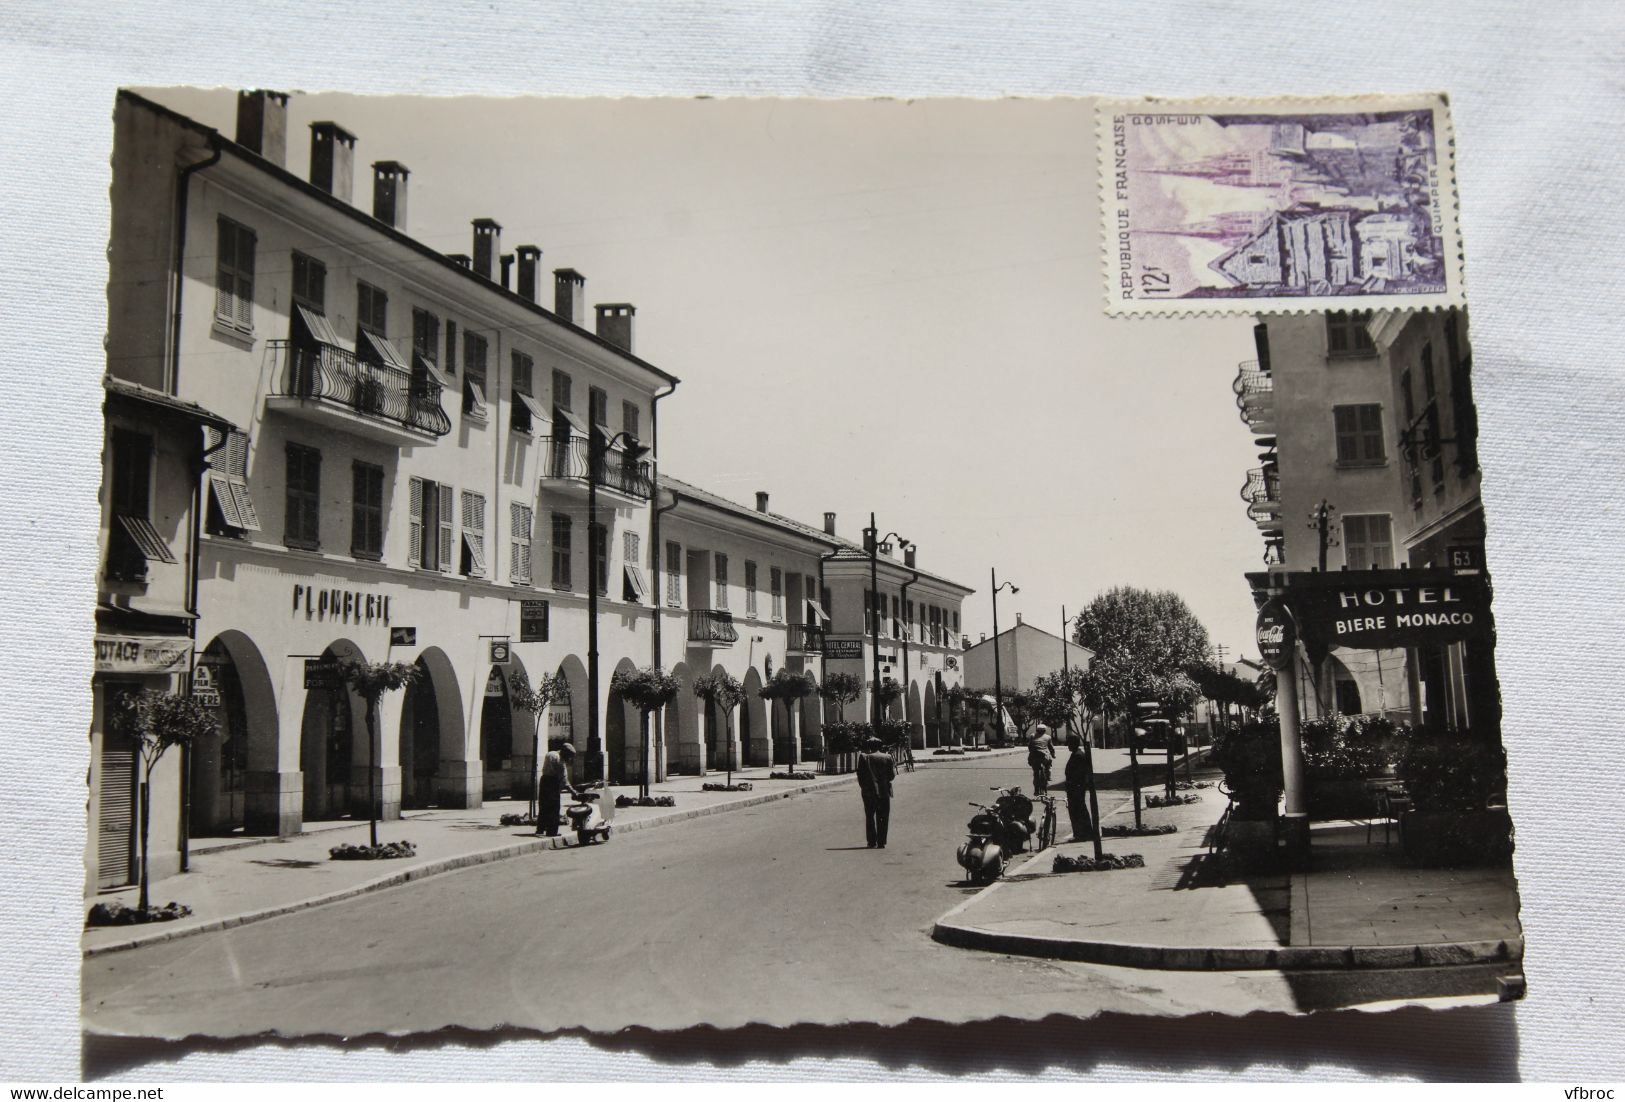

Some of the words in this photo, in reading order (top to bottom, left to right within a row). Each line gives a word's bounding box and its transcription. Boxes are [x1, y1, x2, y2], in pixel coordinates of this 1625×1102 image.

[1132, 115, 1201, 126] POSTES
[1430, 169, 1443, 234] QUIMPER
[1453, 551, 1471, 567] 63
[294, 583, 393, 621] PLOMBERIE
[1339, 587, 1461, 608] HOTEL
[1335, 616, 1387, 635] BIERE
[1396, 612, 1474, 628] MONACO
